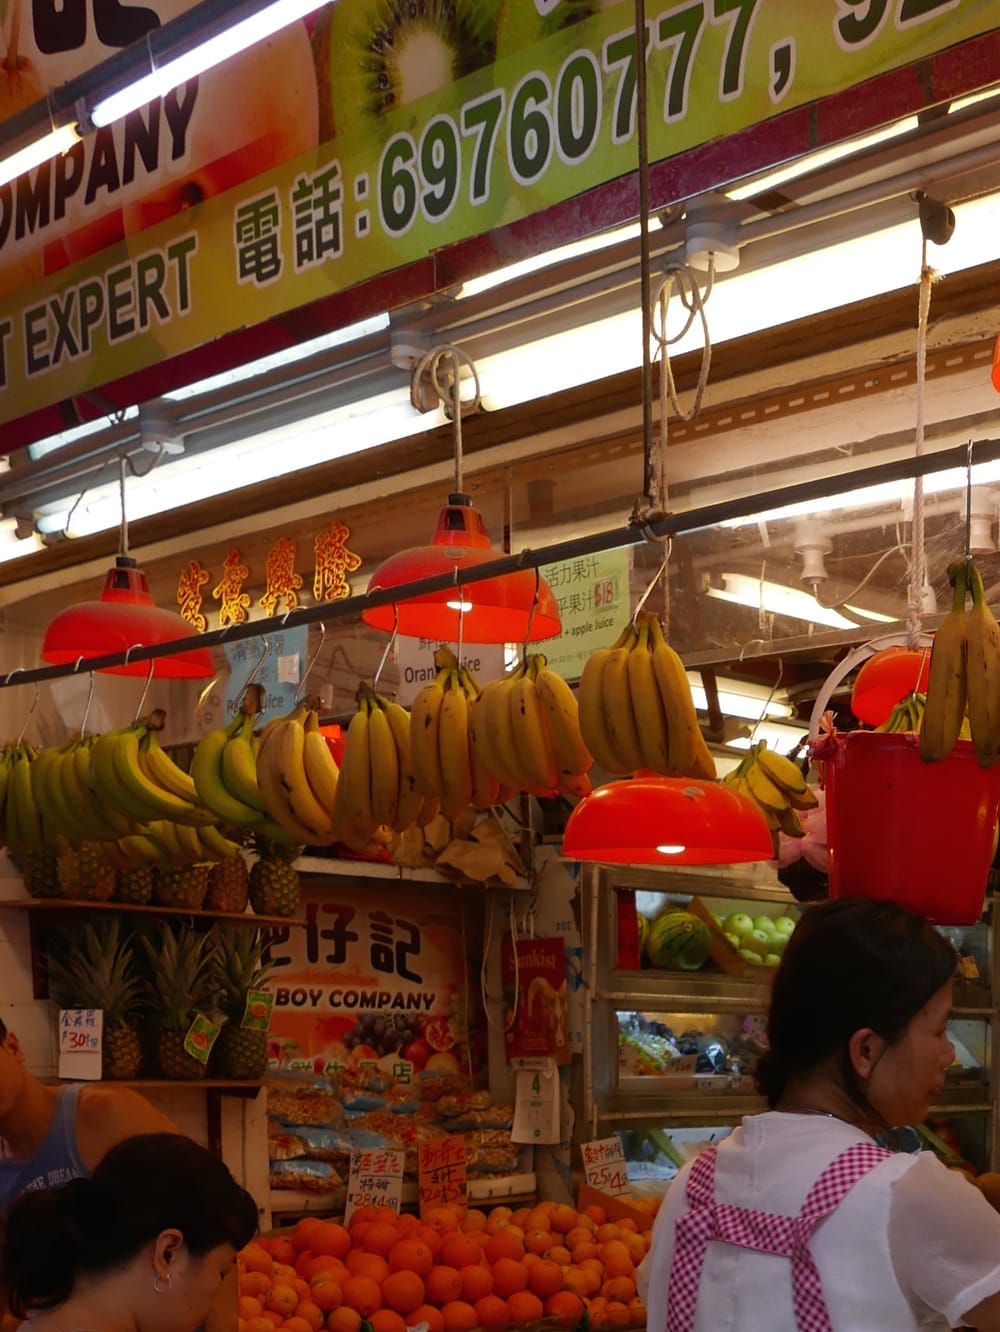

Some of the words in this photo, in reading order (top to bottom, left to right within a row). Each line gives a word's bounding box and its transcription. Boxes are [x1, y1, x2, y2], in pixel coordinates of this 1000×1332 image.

[24, 236, 197, 371] EXPERT
[275, 988, 323, 1007] BOY
[328, 990, 436, 1010] COMPANY
